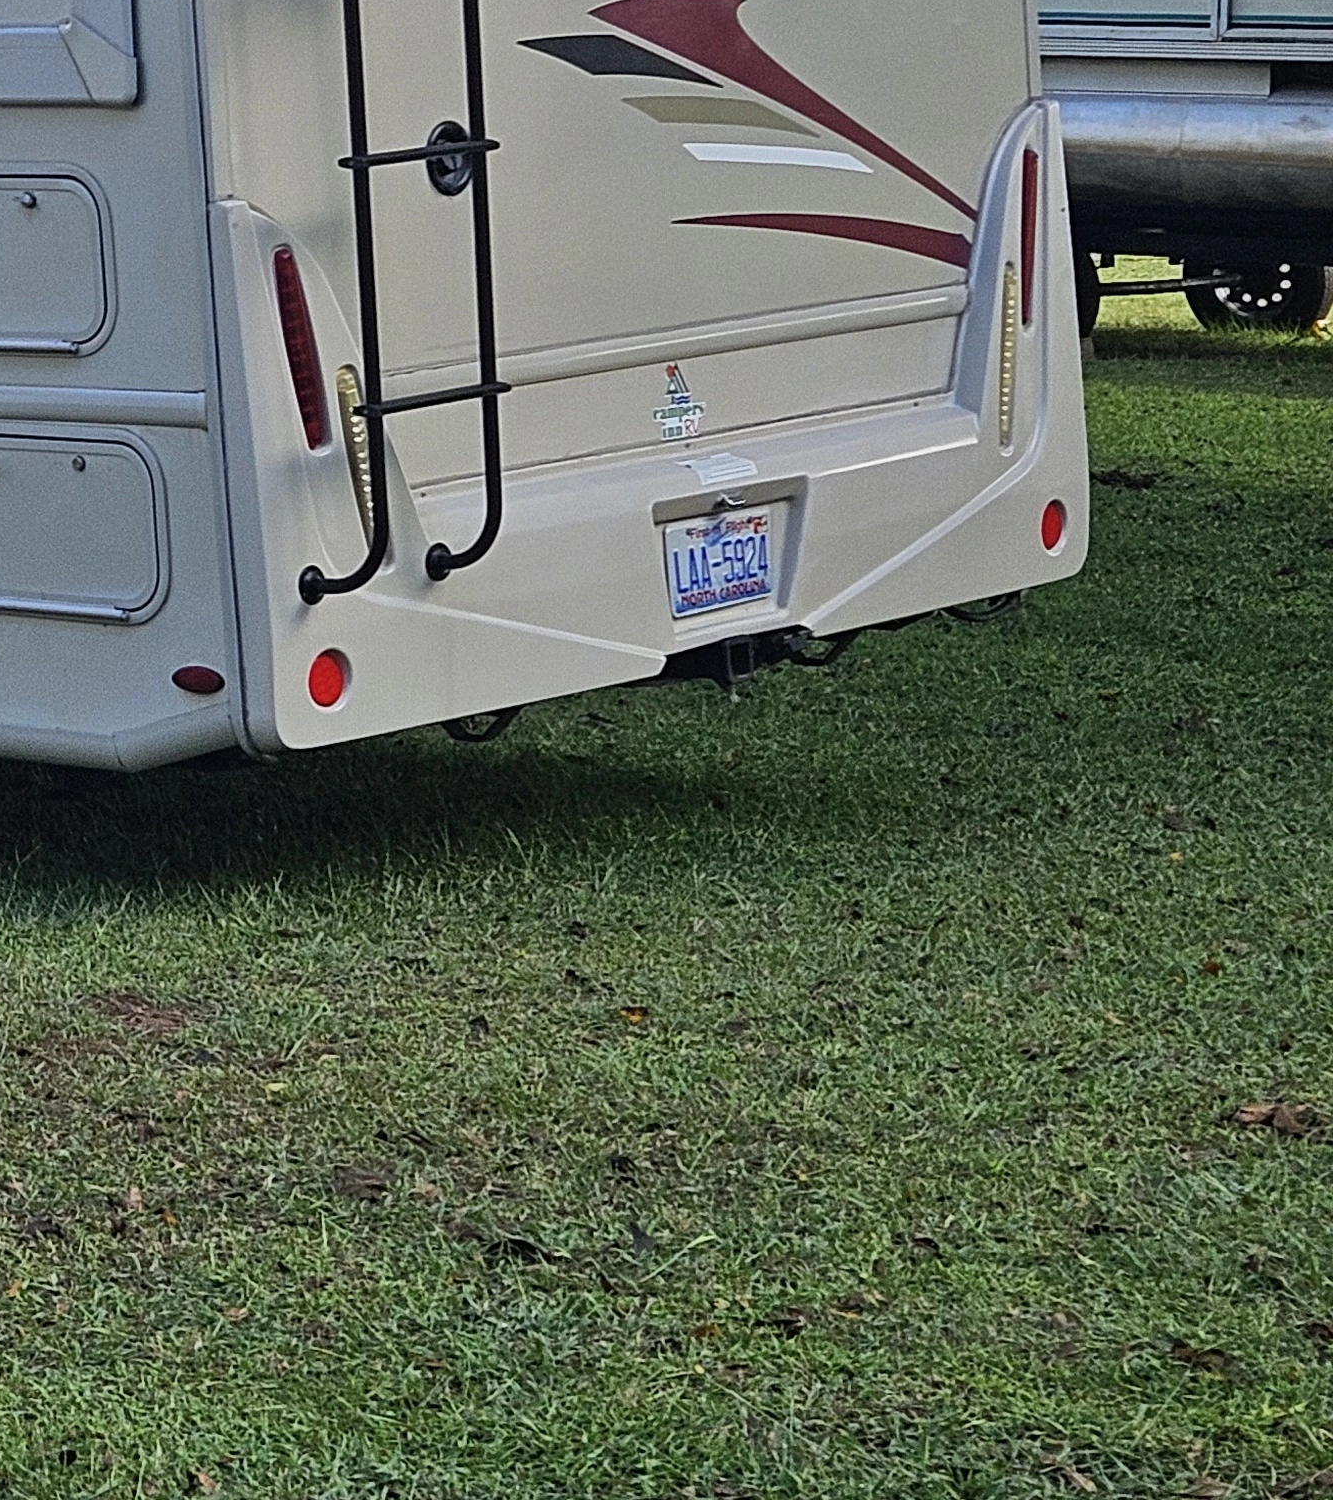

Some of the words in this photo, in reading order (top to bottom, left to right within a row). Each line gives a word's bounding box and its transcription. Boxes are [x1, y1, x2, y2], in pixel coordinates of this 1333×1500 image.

[673, 534, 769, 594] LAA-5924
[680, 588, 717, 608] NORTH
[719, 578, 766, 600] CAROLINA
